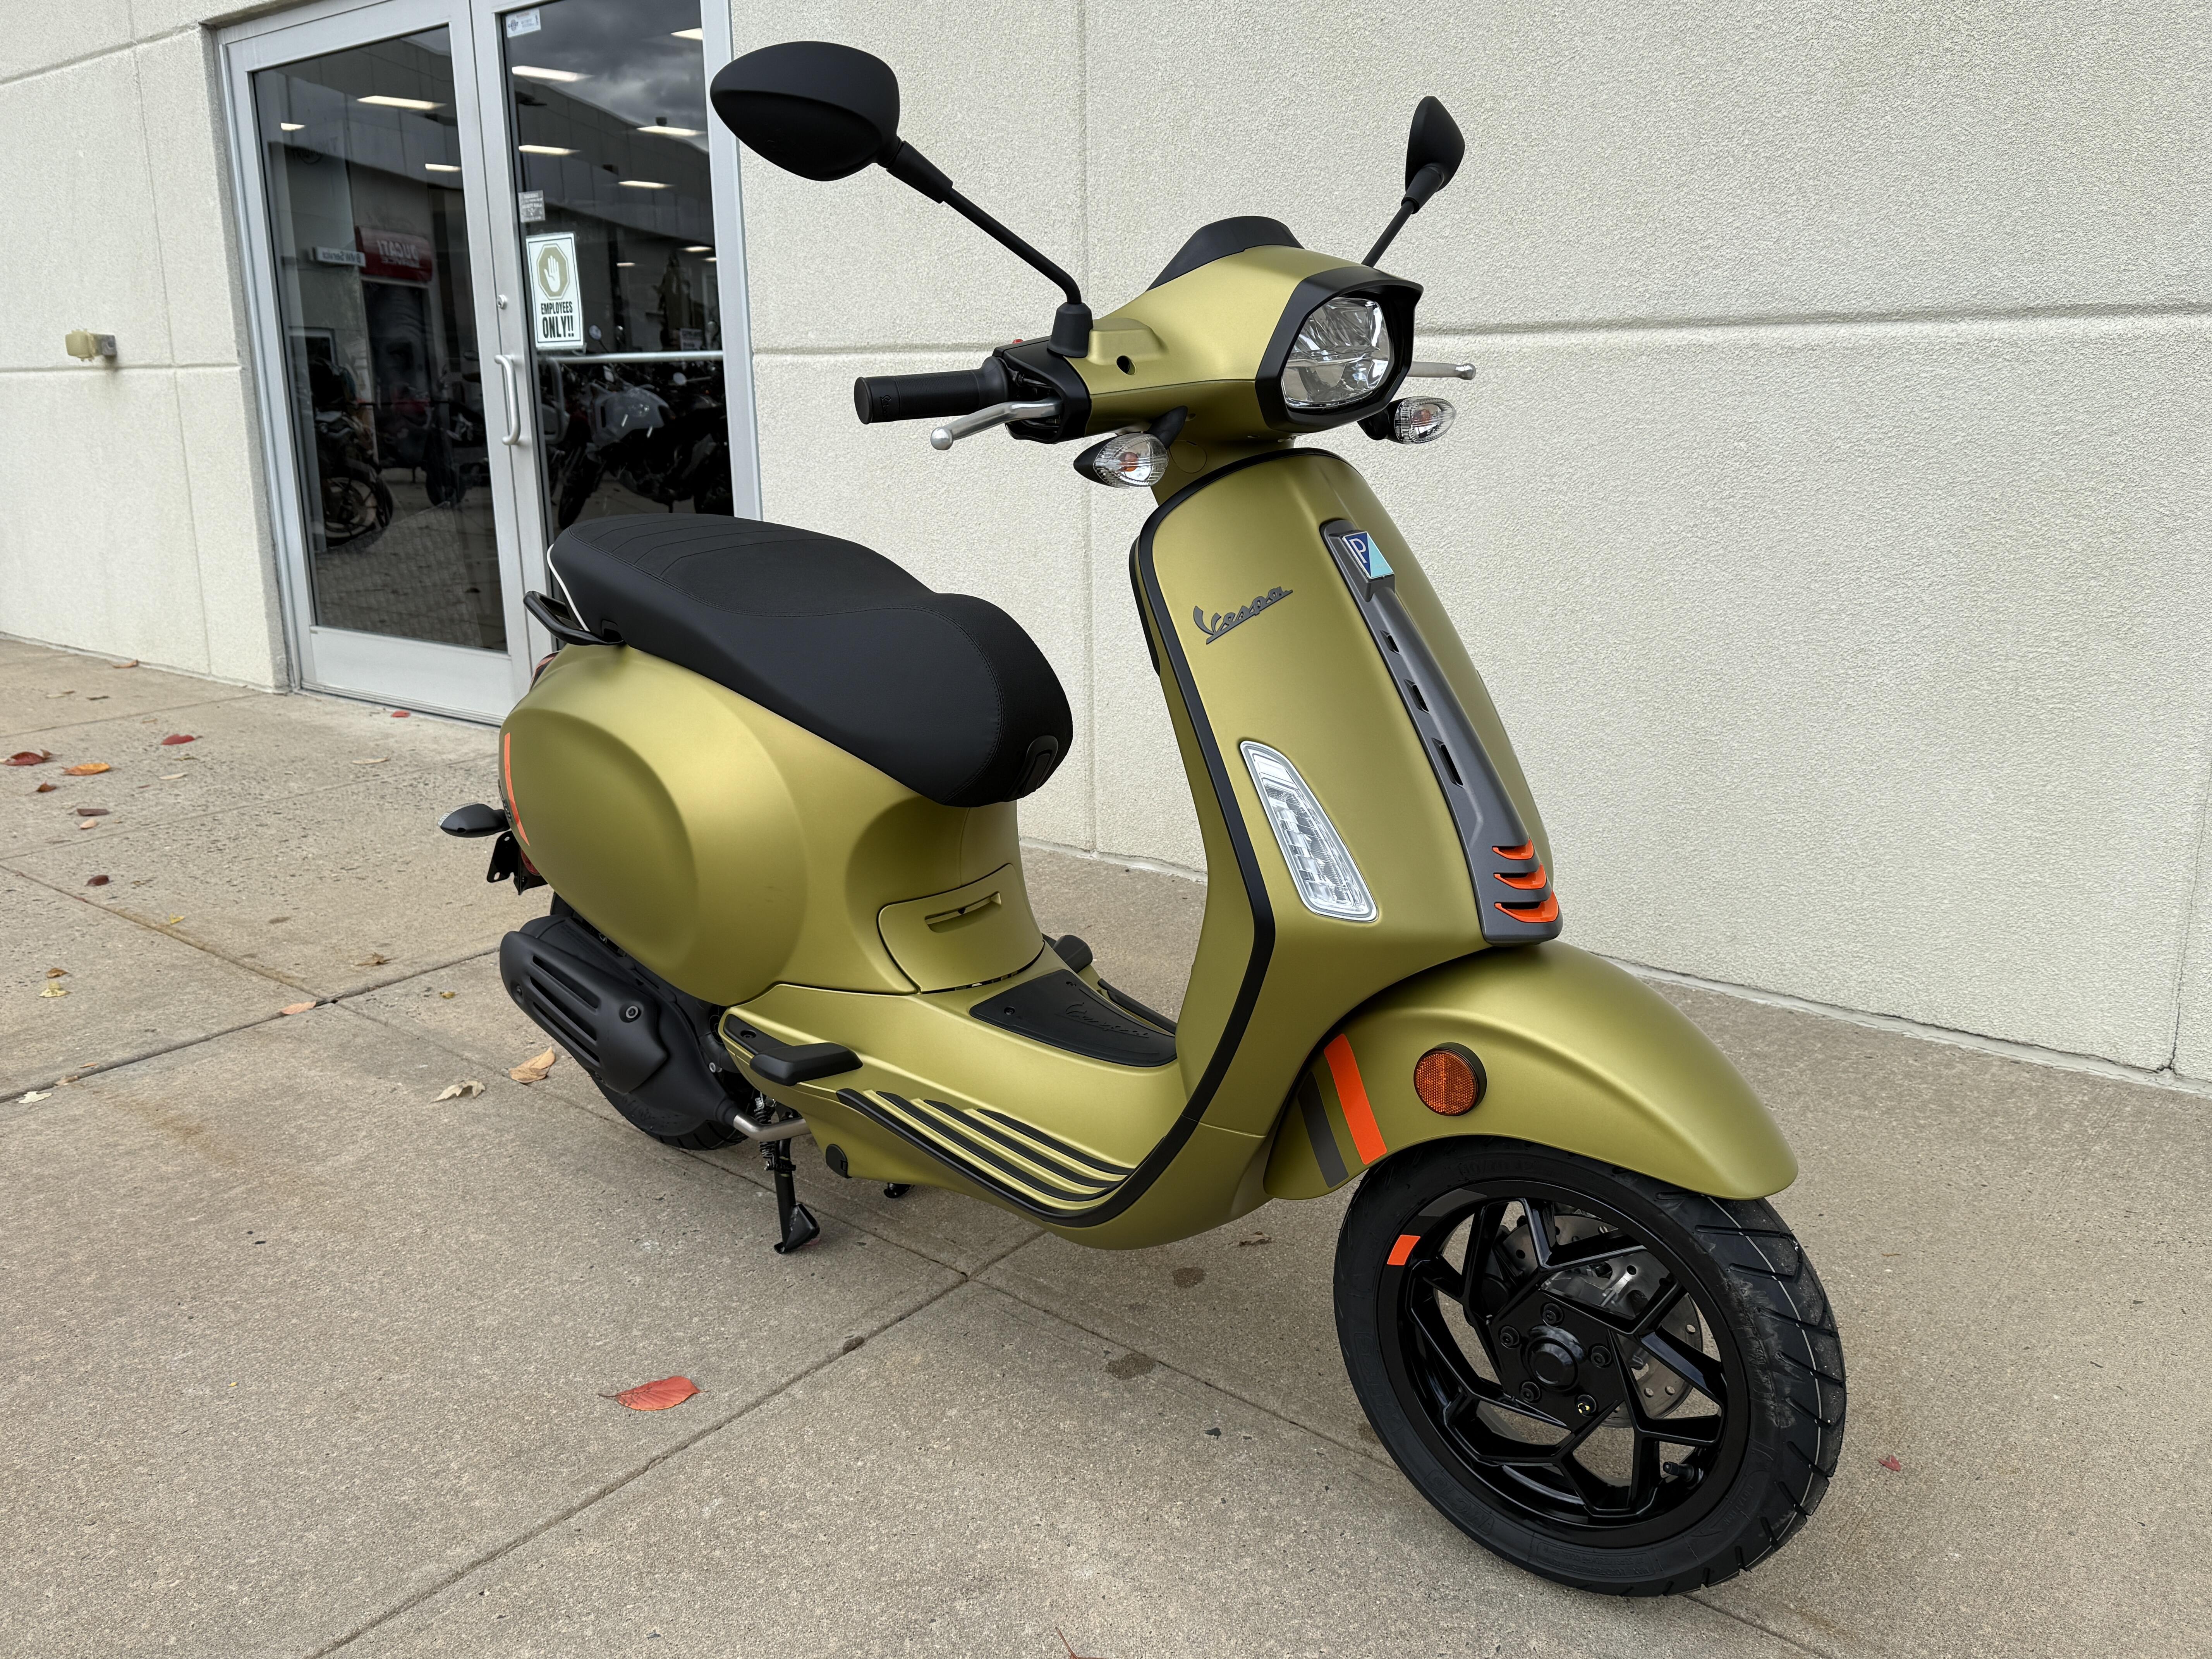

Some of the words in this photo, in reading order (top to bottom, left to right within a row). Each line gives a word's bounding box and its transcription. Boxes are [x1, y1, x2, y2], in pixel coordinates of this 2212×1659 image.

[541, 301, 573, 314] EMPLOYEES
[543, 315, 574, 338] ONLY!!
[1349, 538, 1367, 564] P
[1193, 586, 1293, 645] Vespa
